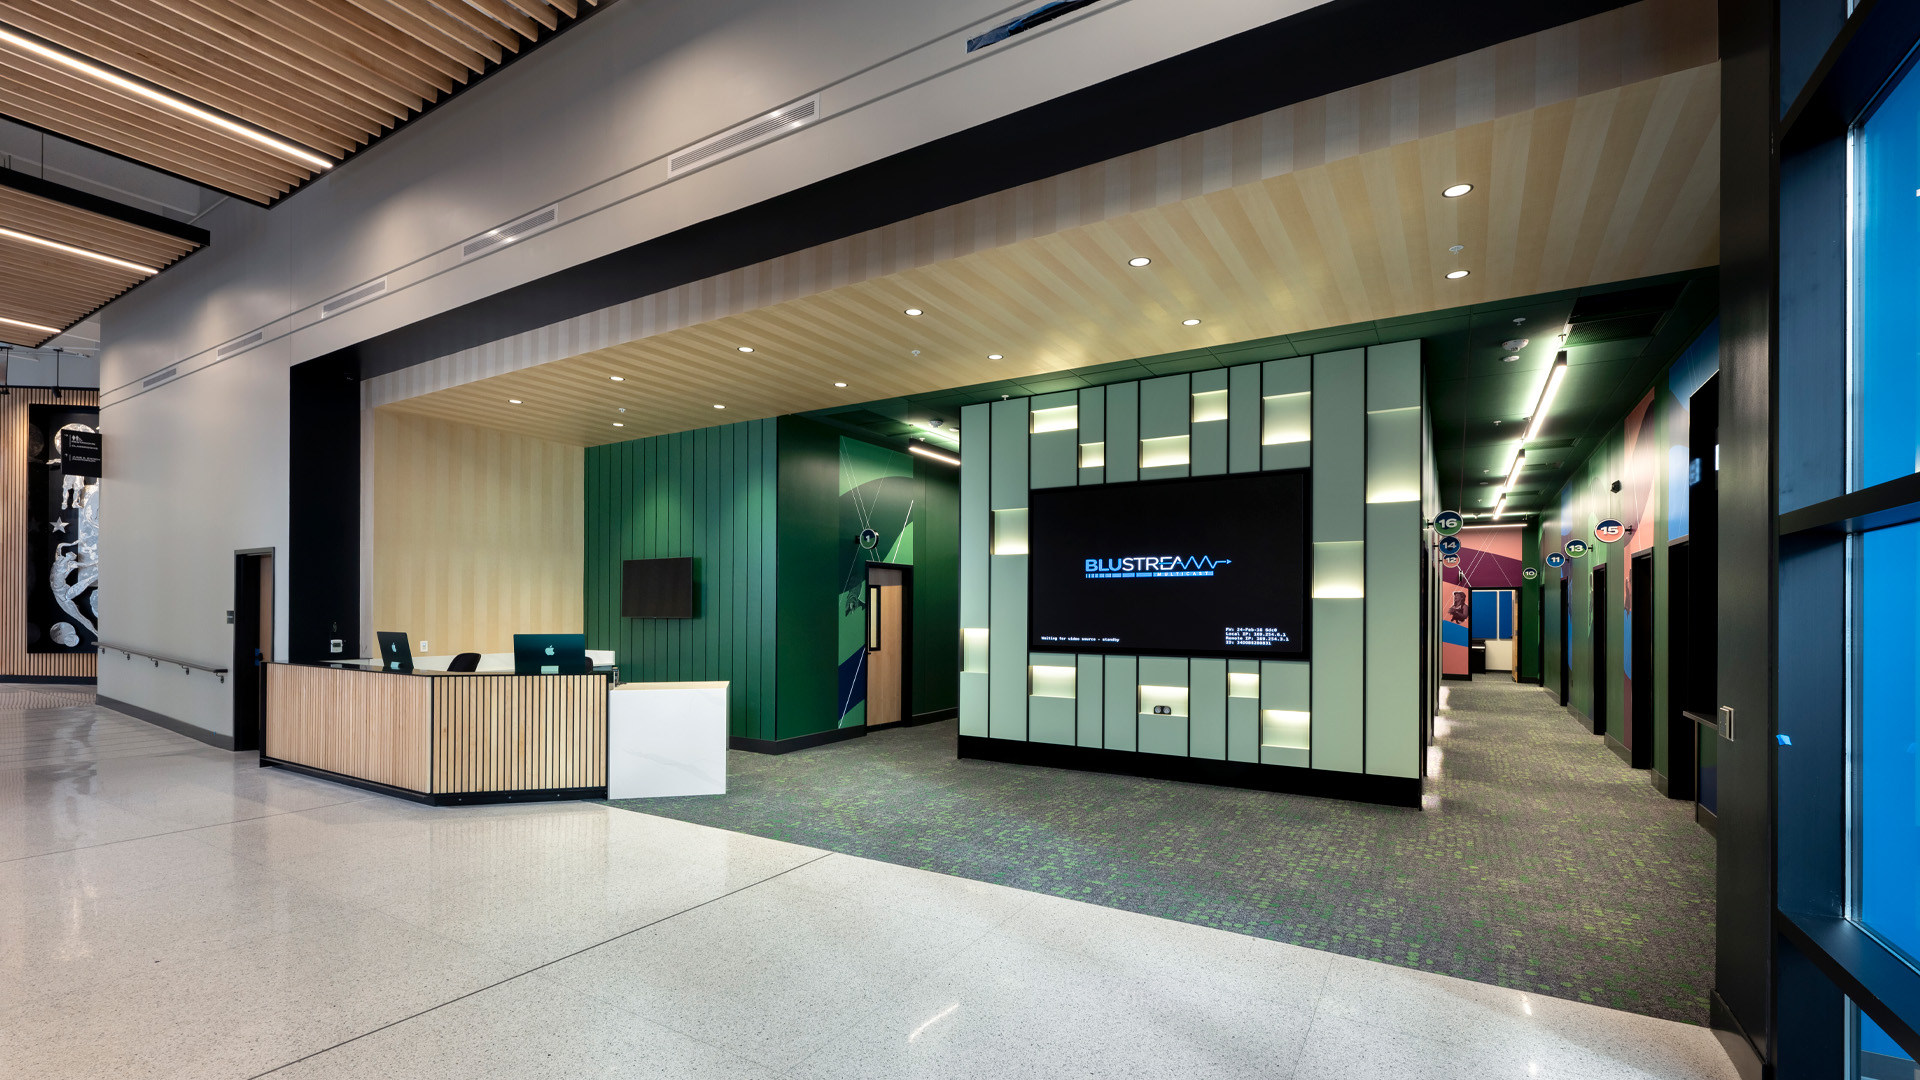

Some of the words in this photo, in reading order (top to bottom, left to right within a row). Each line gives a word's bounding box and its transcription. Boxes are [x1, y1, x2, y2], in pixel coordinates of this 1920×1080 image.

[1438, 518, 1458, 528] 16
[1600, 525, 1619, 535] 15
[1442, 541, 1457, 549] 14
[1568, 544, 1584, 552] 13
